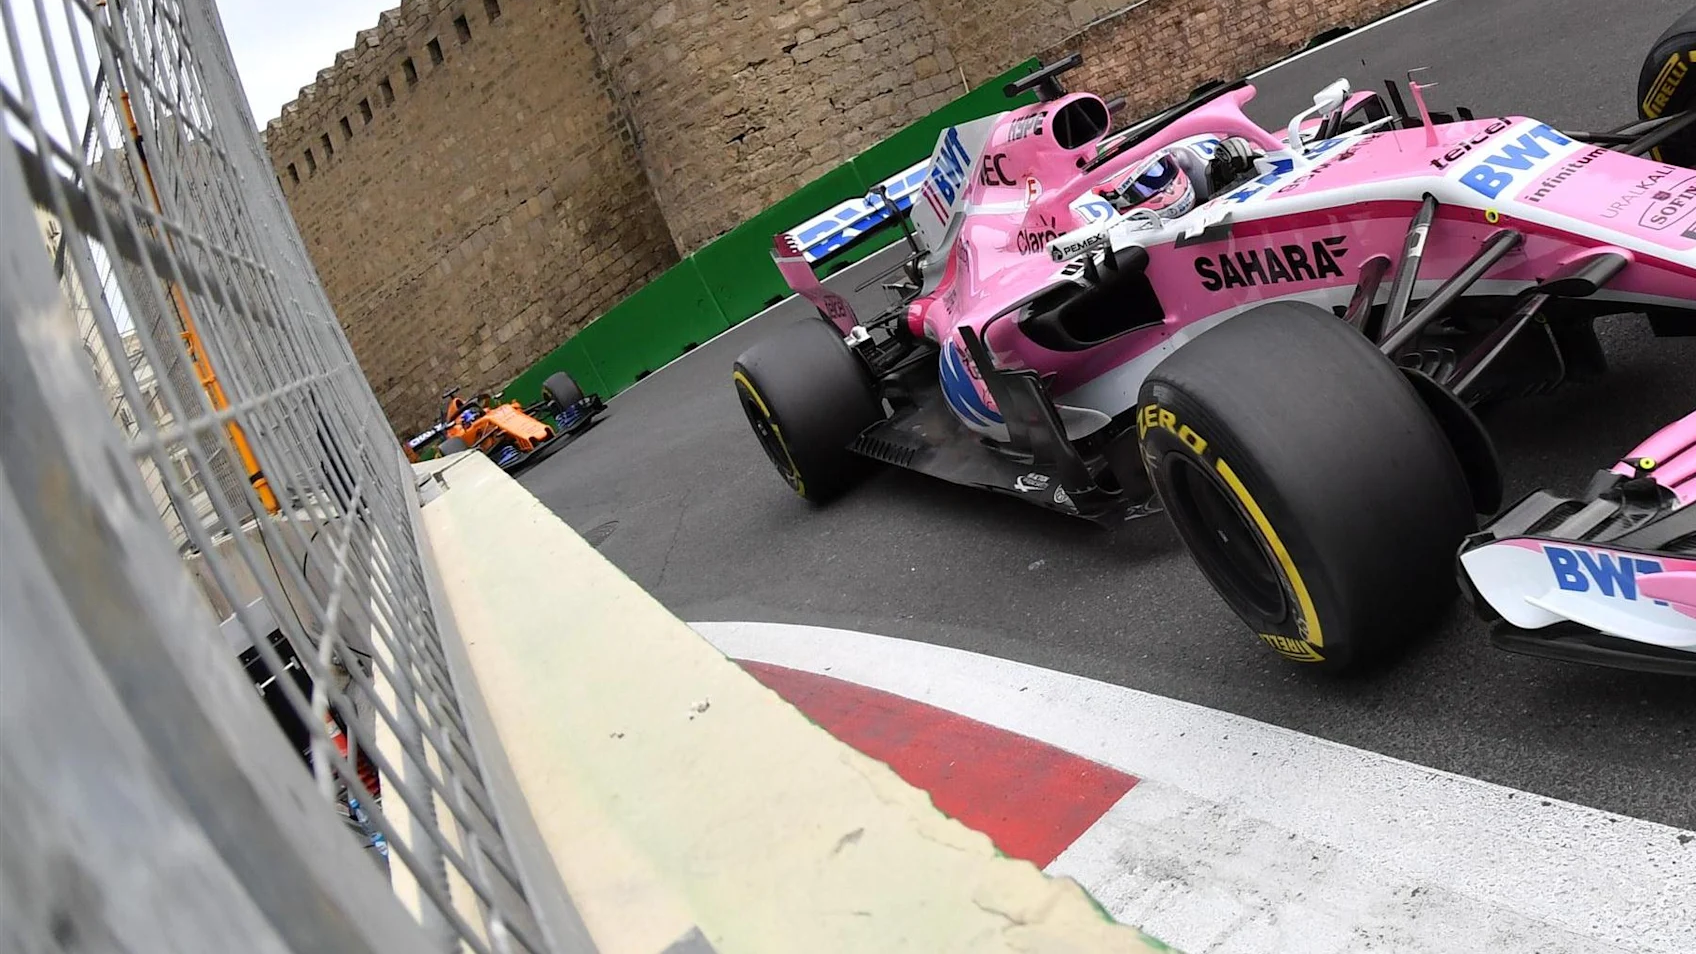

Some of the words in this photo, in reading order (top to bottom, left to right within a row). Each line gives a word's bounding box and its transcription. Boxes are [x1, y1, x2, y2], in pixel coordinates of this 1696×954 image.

[1642, 52, 1688, 120] PIRELLI
[931, 127, 971, 207] BWT
[1430, 117, 1512, 170] telcel
[1458, 124, 1573, 200] BWT
[1525, 148, 1608, 203] infinitum
[1600, 165, 1677, 219] URALKALI
[1063, 233, 1101, 256] PEMEX
[1194, 240, 1344, 292] SAHARA
